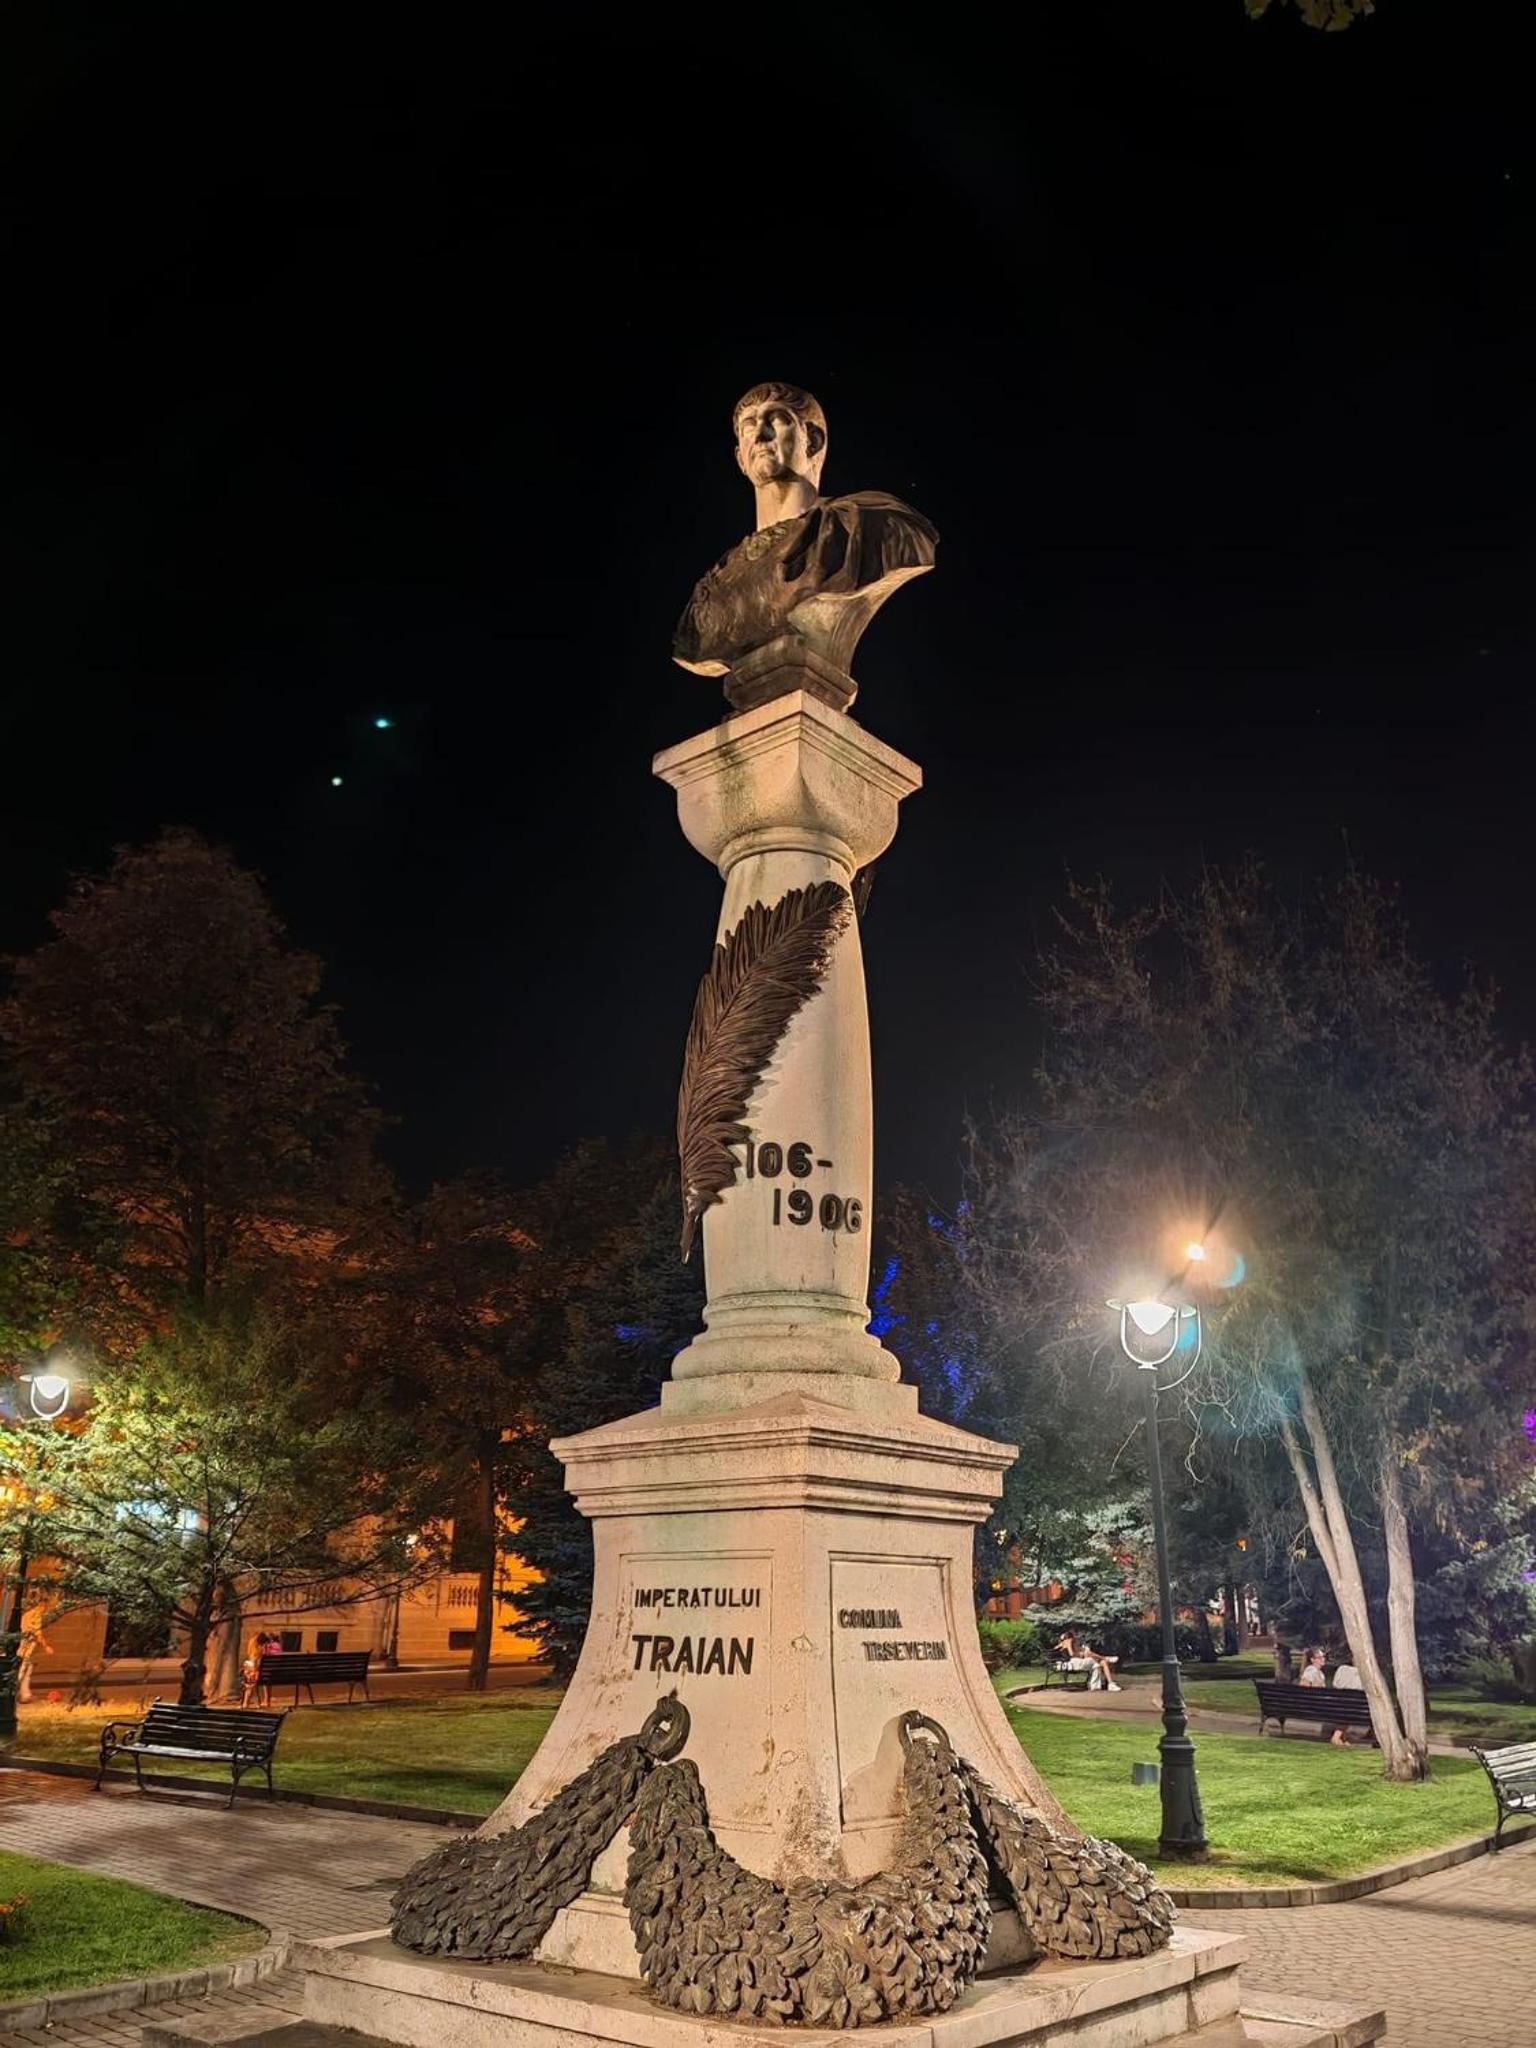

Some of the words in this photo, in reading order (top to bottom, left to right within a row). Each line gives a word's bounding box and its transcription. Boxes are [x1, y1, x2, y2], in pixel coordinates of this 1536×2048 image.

[773, 1188, 863, 1234] 1906
[634, 1587, 761, 1608] IMPERATULUI
[632, 1634, 755, 1676] TRAIAN
